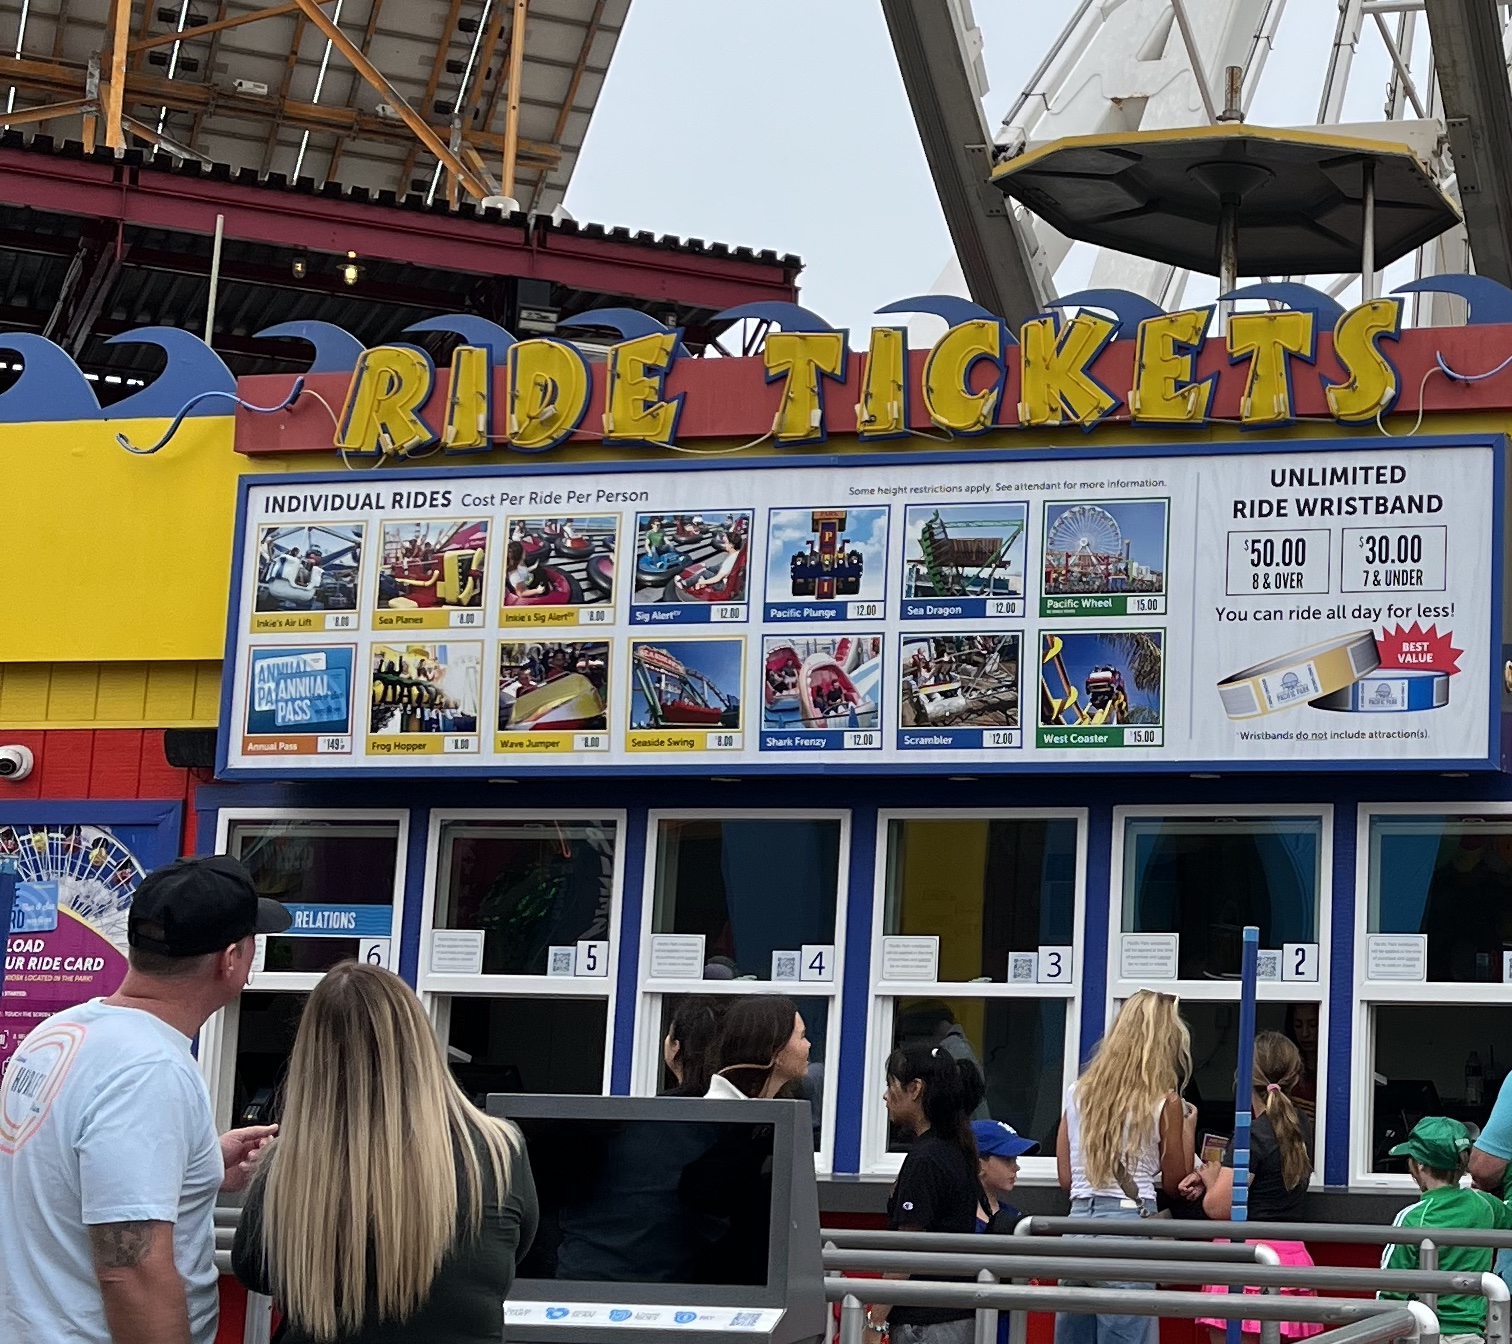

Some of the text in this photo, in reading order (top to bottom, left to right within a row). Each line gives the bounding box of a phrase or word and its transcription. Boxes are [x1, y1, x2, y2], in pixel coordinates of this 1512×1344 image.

[334, 297, 1404, 456] RIDE TICKETS
[1271, 465, 1406, 487] UNLIMITED
[849, 486, 875, 496] Some
[877, 485, 907, 495] height
[910, 484, 962, 494] restrictions
[965, 483, 992, 494] apply.
[995, 482, 1013, 491] See
[1015, 481, 1061, 491] attendant
[1063, 481, 1077, 489] for
[1107, 479, 1166, 488] information.
[264, 489, 649, 513] INDIVIDUAL RIDES Cost Per Ride Per Person
[1233, 495, 1443, 519] RIDE WRISTBAND
[1244, 537, 1306, 567] $50.00
[1359, 534, 1422, 564] $30.00
[1252, 572, 1304, 590] 8 & OVER
[1363, 569, 1423, 587] 7 & UNDER
[907, 606, 962, 616] Sea Dragon
[1047, 598, 1112, 609] Pacific Wheel
[379, 615, 423, 624] Sea Planes
[533, 613, 545, 623] Sig
[636, 611, 650, 622] Sig
[770, 608, 801, 618] Pacific
[803, 608, 836, 619] Plunge
[1216, 603, 1455, 625] You can ride all day for less!
[284, 619, 297, 627] Air
[298, 618, 312, 626] Lift
[1402, 642, 1429, 652] BEST
[1398, 653, 1433, 663] VALUE
[277, 675, 330, 699] ANNUAL
[277, 700, 310, 723] PASS
[766, 736, 826, 748] Shark Frenzy
[904, 735, 953, 745] Scrambler
[1044, 734, 1108, 744] West Coaster
[1296, 730, 1430, 740] do not include attraction(s).
[248, 742, 297, 751] Annual Pass
[372, 741, 426, 752] Frog Hopper
[500, 739, 560, 750] Wave Jumper
[632, 738, 694, 749] Seaside Swing
[294, 911, 356, 929] RELATIONS
[367, 945, 381, 966] 6
[587, 945, 597, 970] 5
[1294, 947, 1306, 977] 2
[27, 957, 105, 971] RIDE CARD
[807, 951, 826, 976] 4
[1047, 952, 1063, 979] 3
